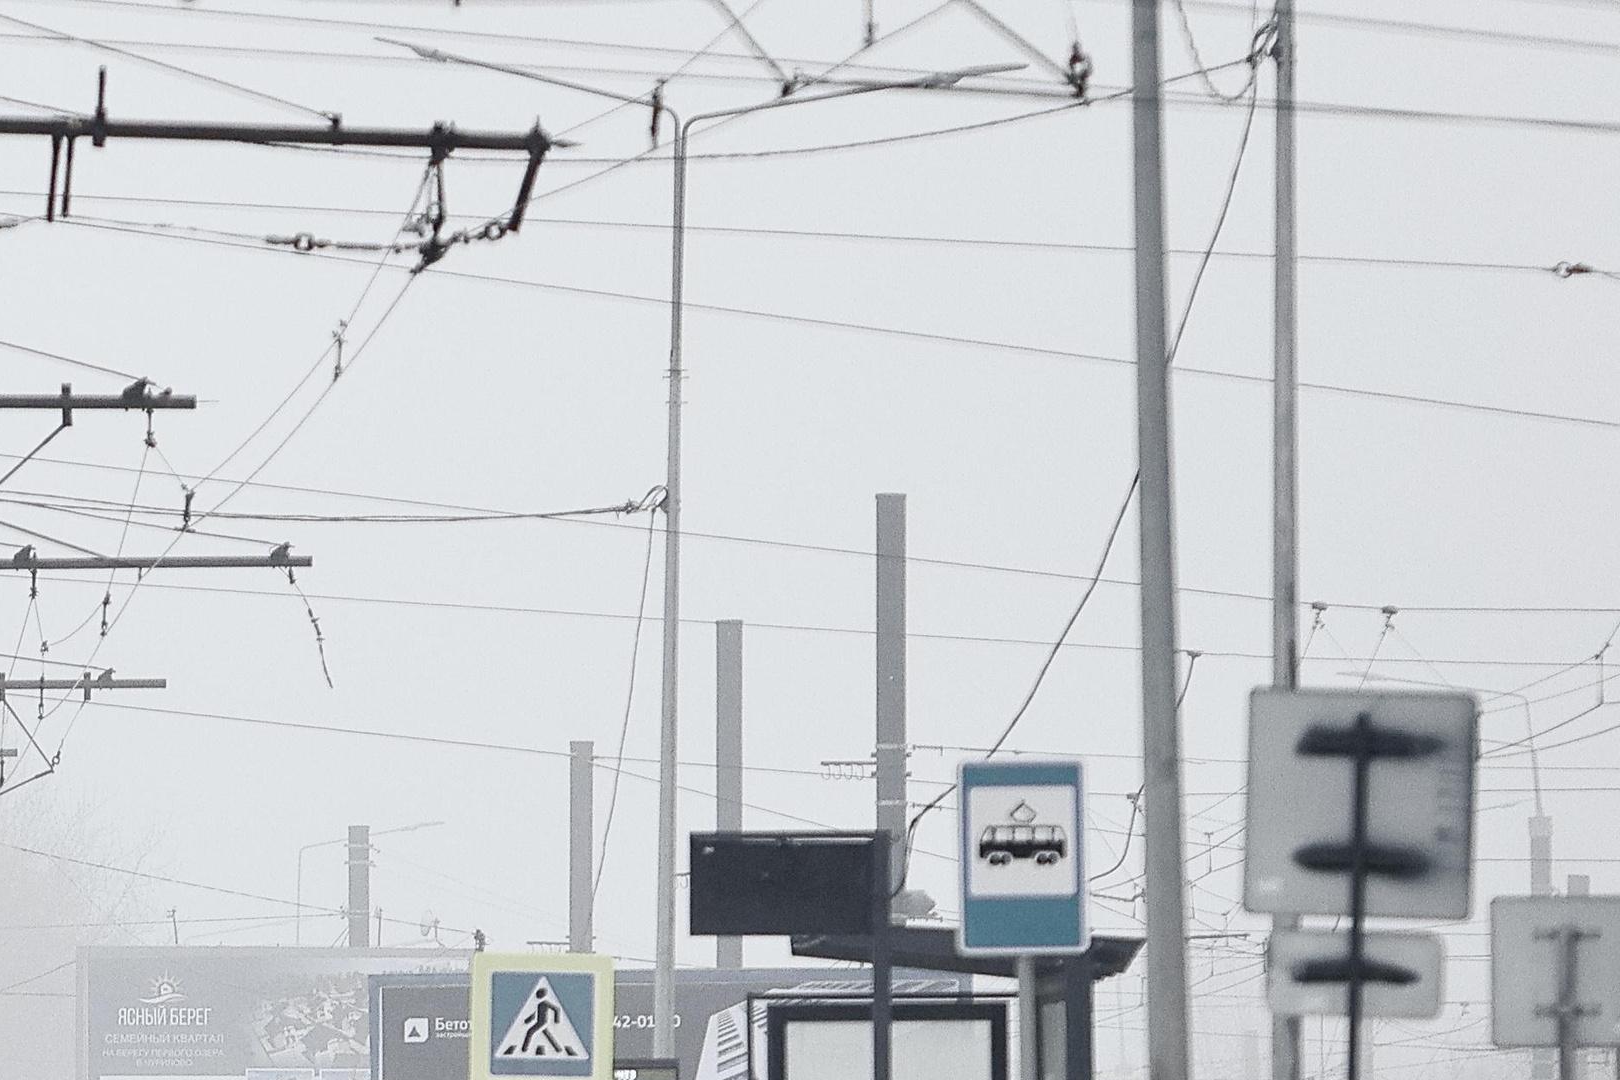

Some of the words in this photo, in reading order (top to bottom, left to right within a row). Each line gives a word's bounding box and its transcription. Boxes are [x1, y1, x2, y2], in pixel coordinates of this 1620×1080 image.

[118, 1005, 167, 1026] ЯСНЫЙ
[170, 1007, 212, 1026] БЕРЕГ
[173, 1033, 225, 1044] КВАРТАЛ
